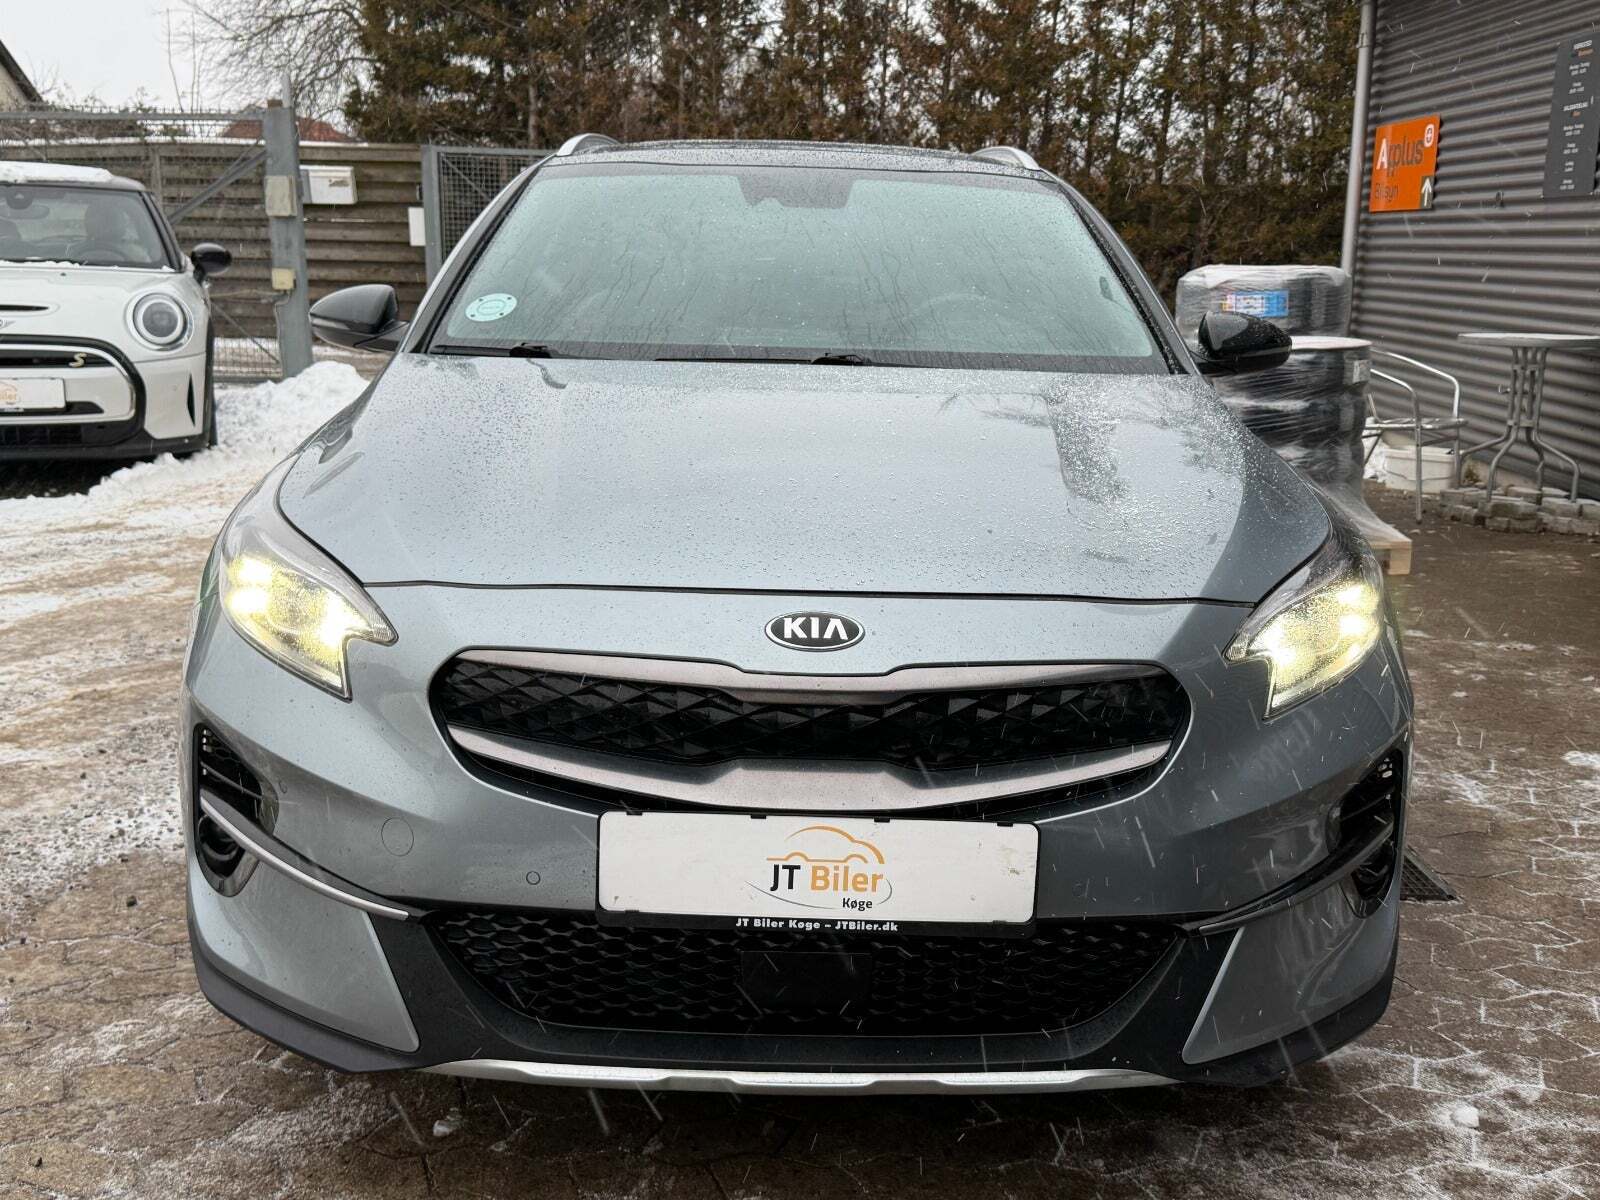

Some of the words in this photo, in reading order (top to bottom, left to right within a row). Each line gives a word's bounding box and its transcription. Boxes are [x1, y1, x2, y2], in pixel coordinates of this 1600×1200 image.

[68, 352, 87, 368] S
[783, 617, 848, 640] KIA
[770, 864, 800, 891] JT
[811, 866, 883, 892] Biler
[842, 897, 872, 911] Køge
[736, 918, 749, 927] JT
[754, 919, 784, 928] Biler
[835, 921, 898, 931] JTBiler.dk
